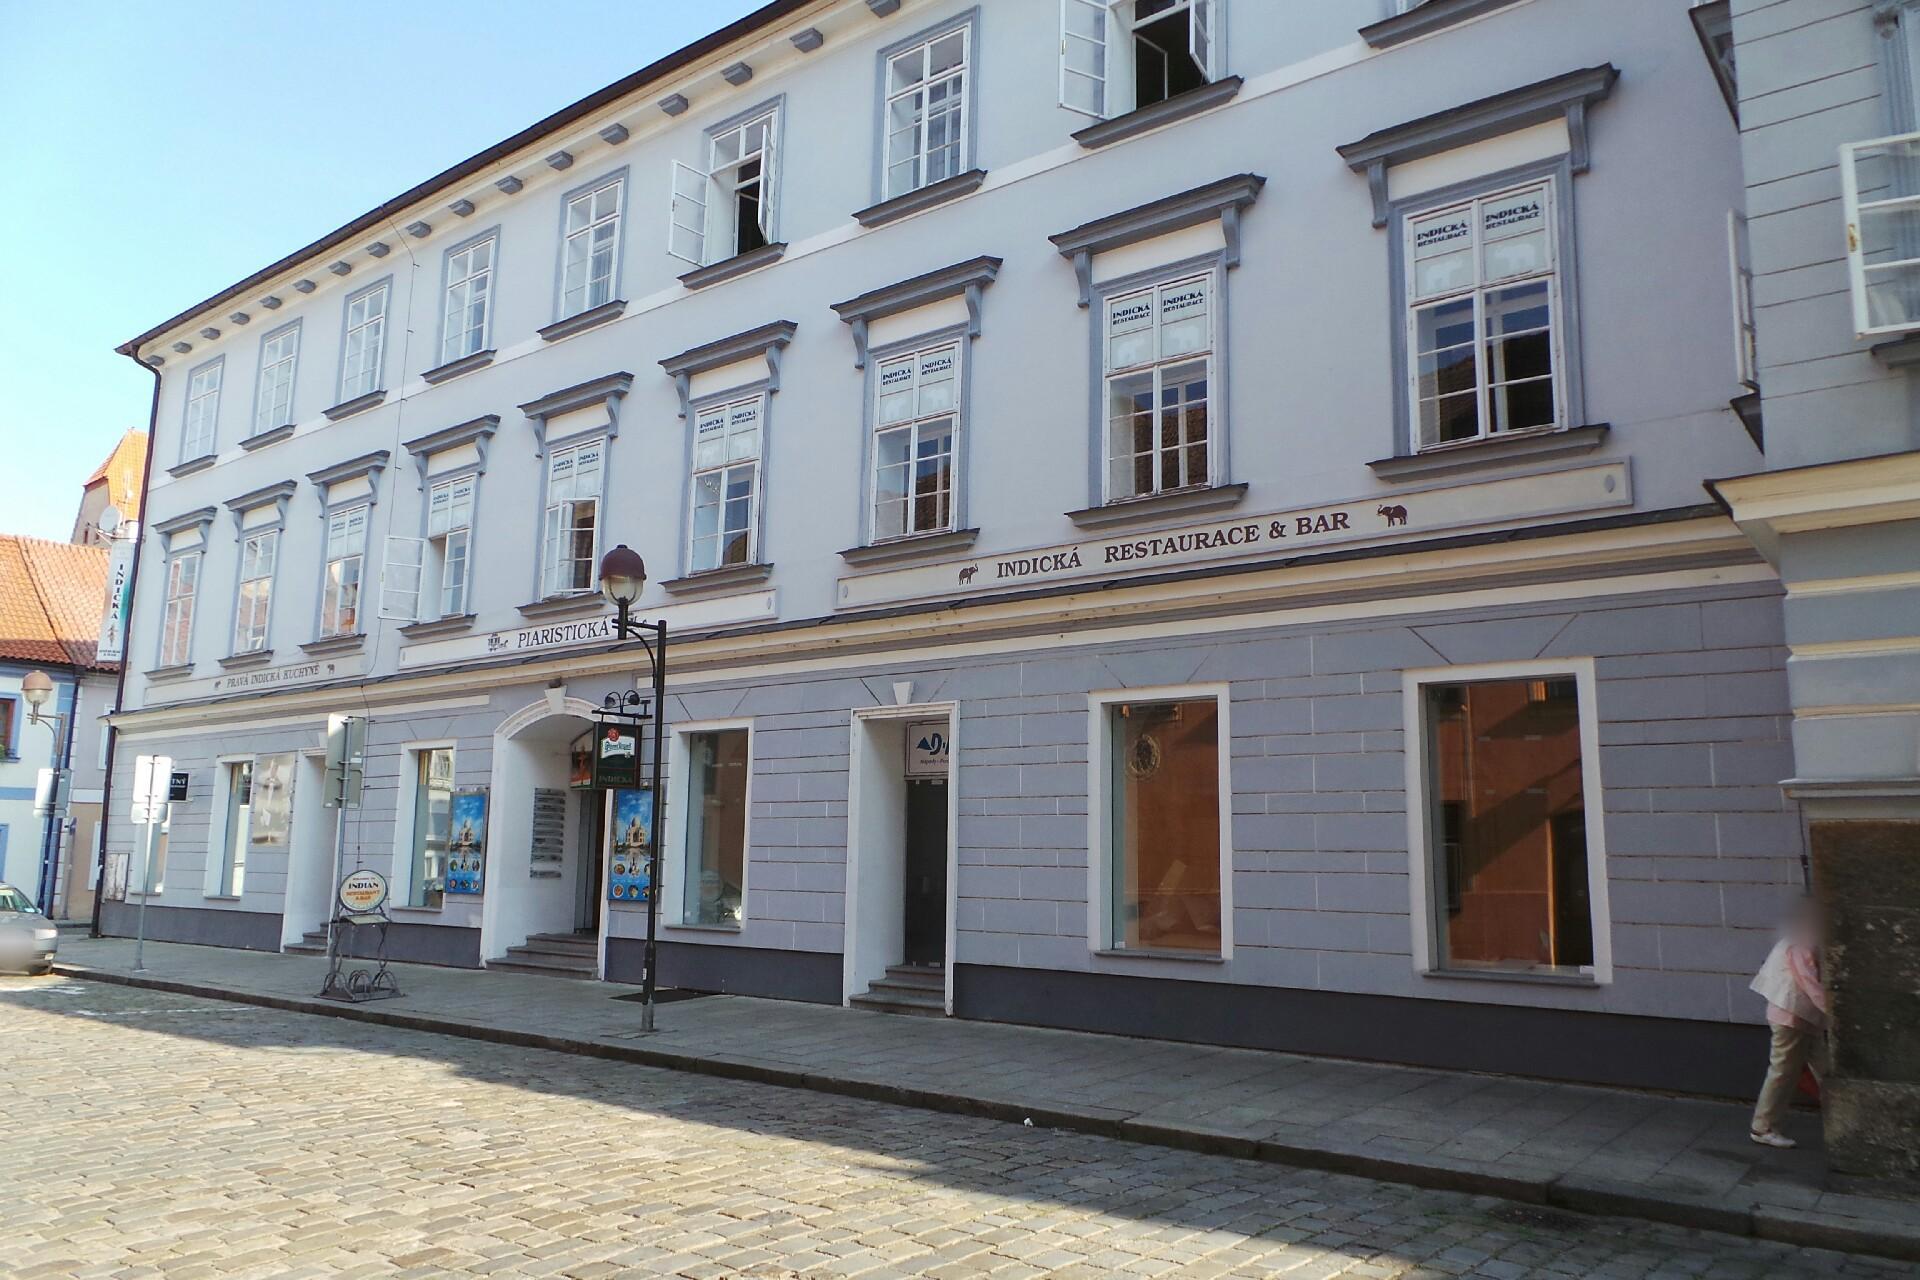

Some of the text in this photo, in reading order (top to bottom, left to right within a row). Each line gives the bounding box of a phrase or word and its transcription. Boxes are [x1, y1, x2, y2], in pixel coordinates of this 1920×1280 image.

[1486, 201, 1539, 222] INDICKÁ
[1486, 211, 1539, 230] RESTAURACE
[1417, 220, 1468, 240] INDICKÁ
[1417, 229, 1468, 247] RESTAURACE
[1163, 289, 1203, 306] INDICKÁ
[1112, 303, 1150, 319] INDICKÁ
[921, 356, 952, 370] INDICKÁ
[882, 367, 912, 380] INDICKÁ
[997, 511, 1350, 578] INDICKÁ RESTAURACE & BAR
[112, 563, 125, 620] INDICKÁ
[518, 616, 609, 648] PIARISTICKÁ
[227, 662, 320, 688] PRAVÁ INDICKÁ KUCHYNĚ
